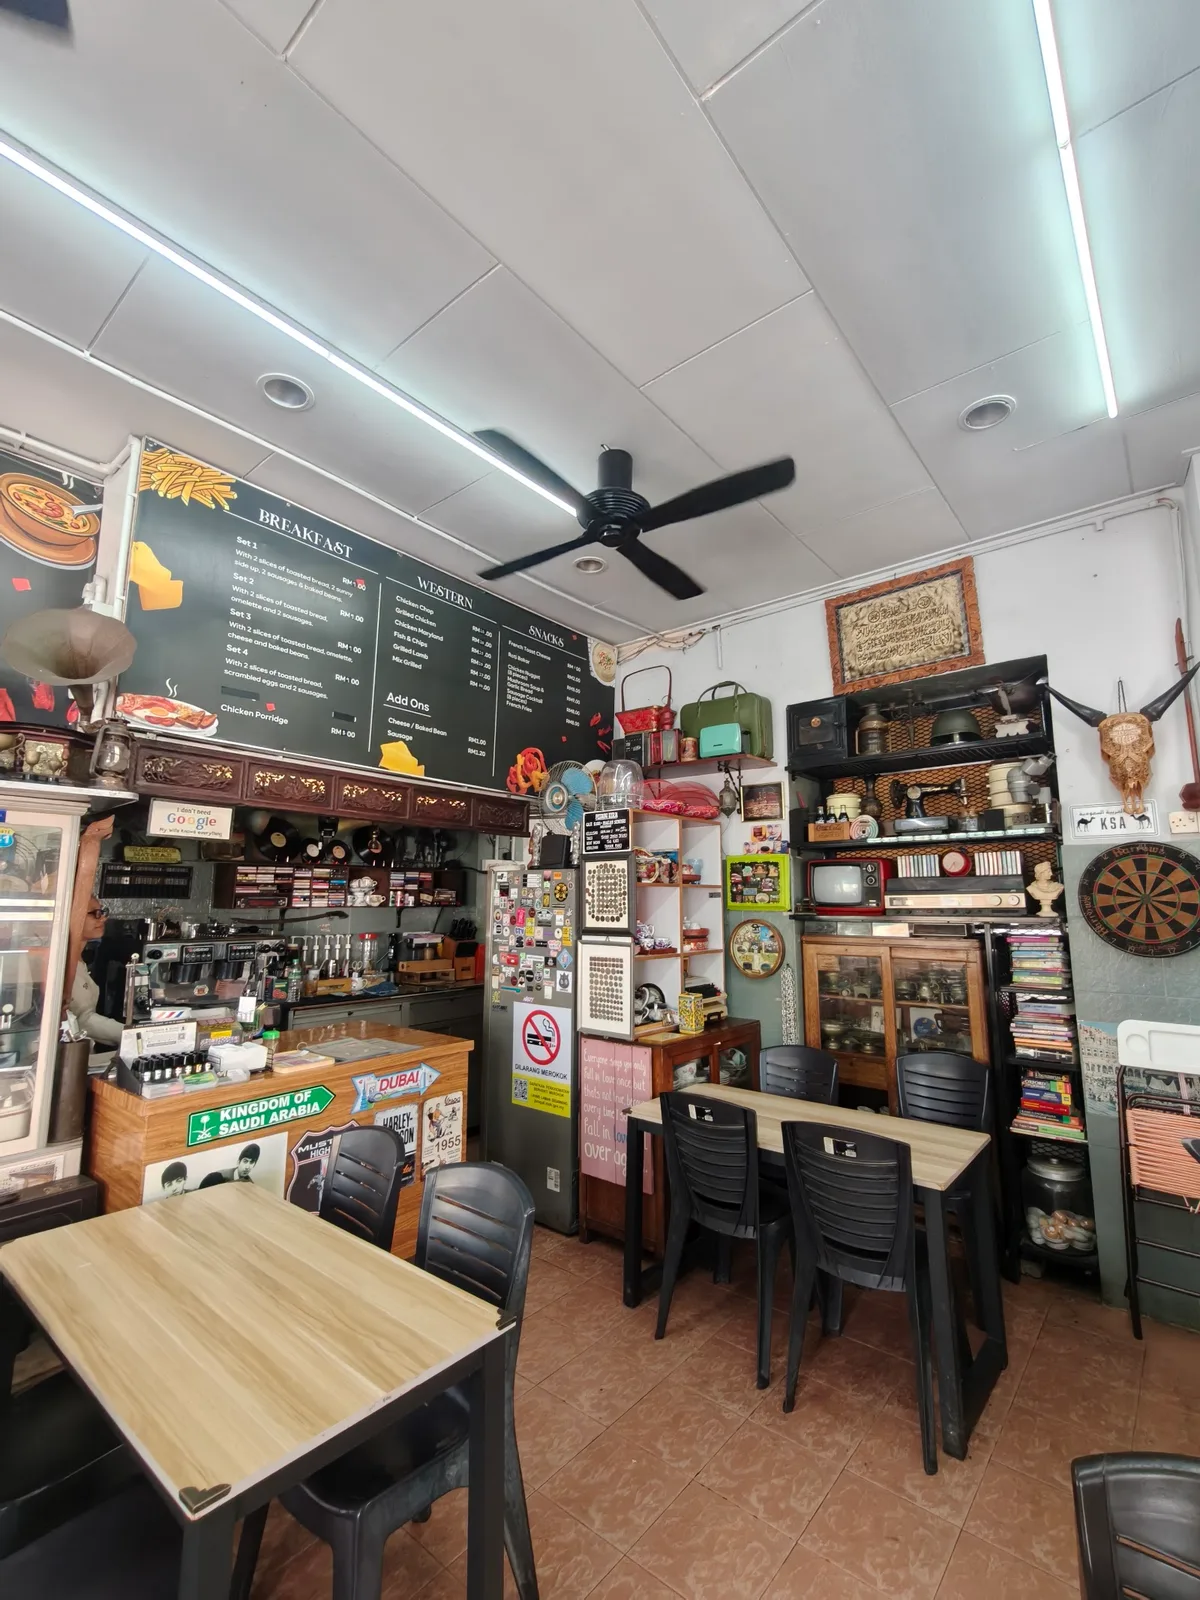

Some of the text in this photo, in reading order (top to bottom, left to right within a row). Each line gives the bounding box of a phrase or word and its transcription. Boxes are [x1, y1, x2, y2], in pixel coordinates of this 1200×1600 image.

[236, 536, 251, 548] Set
[259, 508, 353, 558] BREAKFAST
[233, 572, 248, 584] Set
[234, 559, 249, 569] side
[250, 565, 261, 574] up,
[267, 572, 298, 587] sausages
[304, 584, 323, 595] baked
[324, 592, 343, 603] beans.
[236, 548, 252, 560] With
[259, 558, 277, 569] slices
[286, 568, 311, 582] toasted
[312, 577, 330, 590] bread,
[336, 586, 353, 598] sunny
[417, 576, 473, 609] WESTERN
[230, 608, 245, 618] Set
[231, 596, 262, 609] omelette
[263, 605, 276, 614] and
[283, 612, 314, 626] sausages.
[232, 585, 249, 596] With
[256, 594, 274, 605] slices
[283, 603, 308, 615] toasted
[308, 611, 328, 622] bread,
[396, 595, 434, 615] Chicken Chop
[395, 607, 436, 627] Grilled Chicken
[394, 631, 406, 640] Fish
[412, 637, 428, 648] Chips
[395, 620, 444, 642] Chicken Maryland
[529, 625, 564, 648] SNACKS
[226, 644, 241, 654] Set
[228, 632, 310, 660] cheese and baked beans.
[229, 621, 246, 631] With
[253, 628, 272, 639] slices
[280, 636, 305, 649] toasted
[306, 644, 326, 655] bread,
[326, 650, 354, 663] omelette,
[393, 643, 428, 660] Grilled Lamb
[508, 640, 524, 650] French
[392, 656, 422, 670] Mix Grilled
[508, 664, 541, 680] Chicken Nugget
[225, 658, 242, 668] With
[249, 664, 268, 674] slices
[277, 672, 302, 683] toasted
[303, 678, 323, 688] bread,
[224, 668, 262, 683] scrambled
[262, 679, 278, 688] eggs
[279, 682, 292, 691] and
[298, 687, 328, 699] sausages.
[507, 676, 530, 688] Mushroom
[530, 683, 541, 692] Soup
[507, 682, 520, 690] Garlic
[386, 692, 430, 711] Add Ons
[506, 700, 521, 709] French
[507, 688, 543, 704] Sausage Cocktail
[220, 704, 288, 725] Chicken Porridge
[387, 730, 413, 741] Sausage
[388, 717, 410, 728] Cheese
[415, 724, 432, 733] Baked
[433, 728, 447, 736] Bean
[468, 737, 486, 746] RM1.00
[167, 813, 217, 830] Google
[1100, 816, 1126, 830] KSA
[584, 1048, 608, 1068] Everyone
[633, 1060, 646, 1076] only
[379, 1071, 419, 1092] DUBAI
[515, 1064, 567, 1080] DILARANG MEROKOK
[595, 1072, 601, 1082] in
[634, 1078, 646, 1092] but
[602, 1090, 613, 1102] not
[220, 1090, 312, 1122] KINGDOM OF
[584, 1104, 601, 1120] every
[603, 1104, 615, 1118] time
[219, 1102, 320, 1137] SAUDI ARABIA
[584, 1117, 600, 1138] fall
[602, 1125, 610, 1140] in
[298, 1138, 333, 1154] MUST
[310, 1146, 331, 1159] HIGH
[435, 1135, 461, 1153] 1955
[584, 1142, 612, 1162] over
